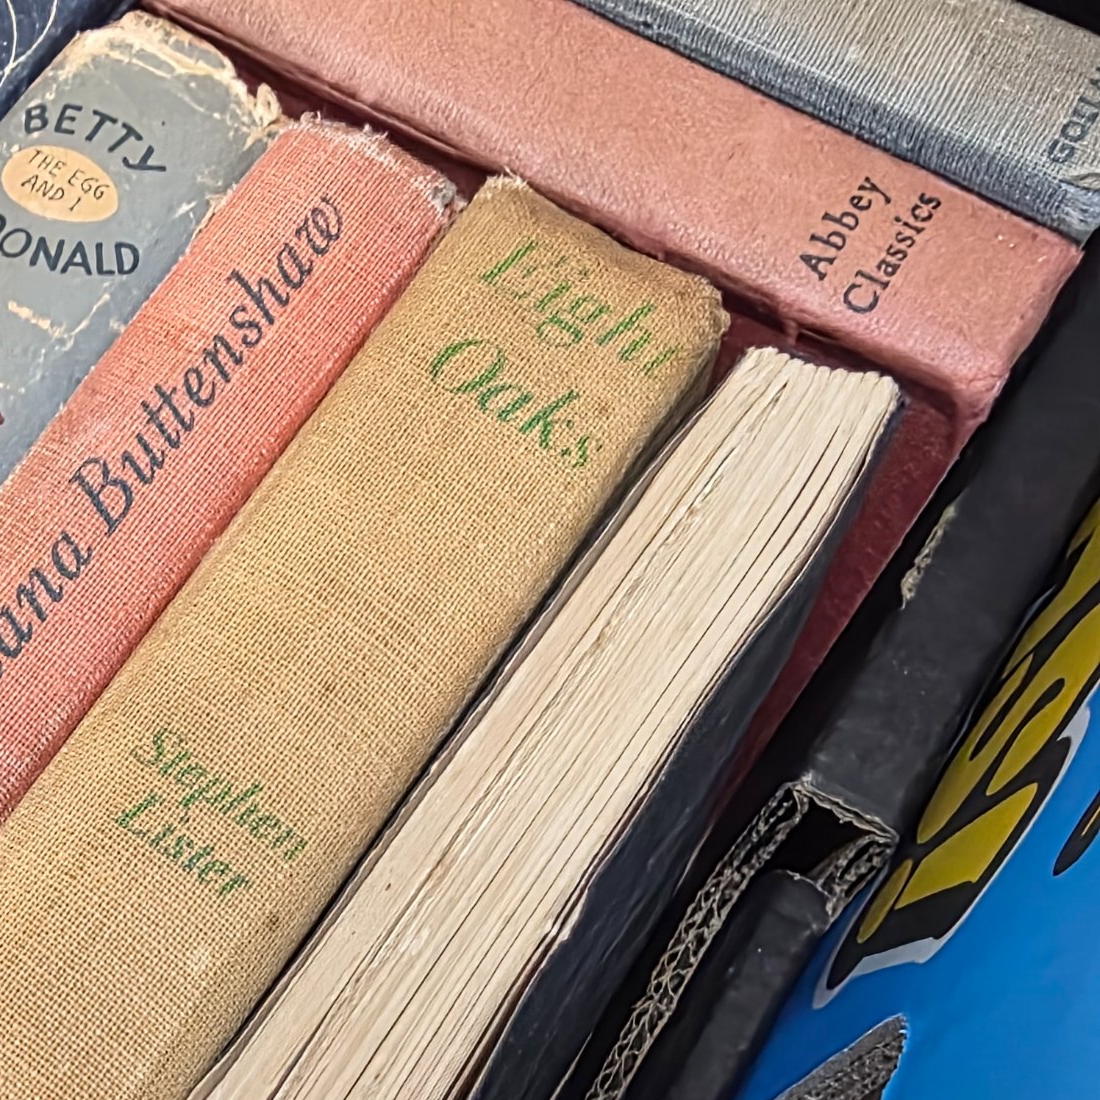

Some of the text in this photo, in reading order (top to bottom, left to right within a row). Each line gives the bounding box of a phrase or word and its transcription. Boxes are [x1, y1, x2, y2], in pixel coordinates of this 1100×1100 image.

[23, 102, 167, 172] BETTY
[28, 149, 110, 200] THE EGG
[20, 174, 83, 213] AND I
[799, 176, 892, 281] Abbey
[843, 192, 942, 314] Classics
[70, 195, 343, 537] Buttenshaw
[429, 338, 602, 470] Oaks
[114, 793, 251, 897] Lister
[131, 727, 306, 861] Stephen
